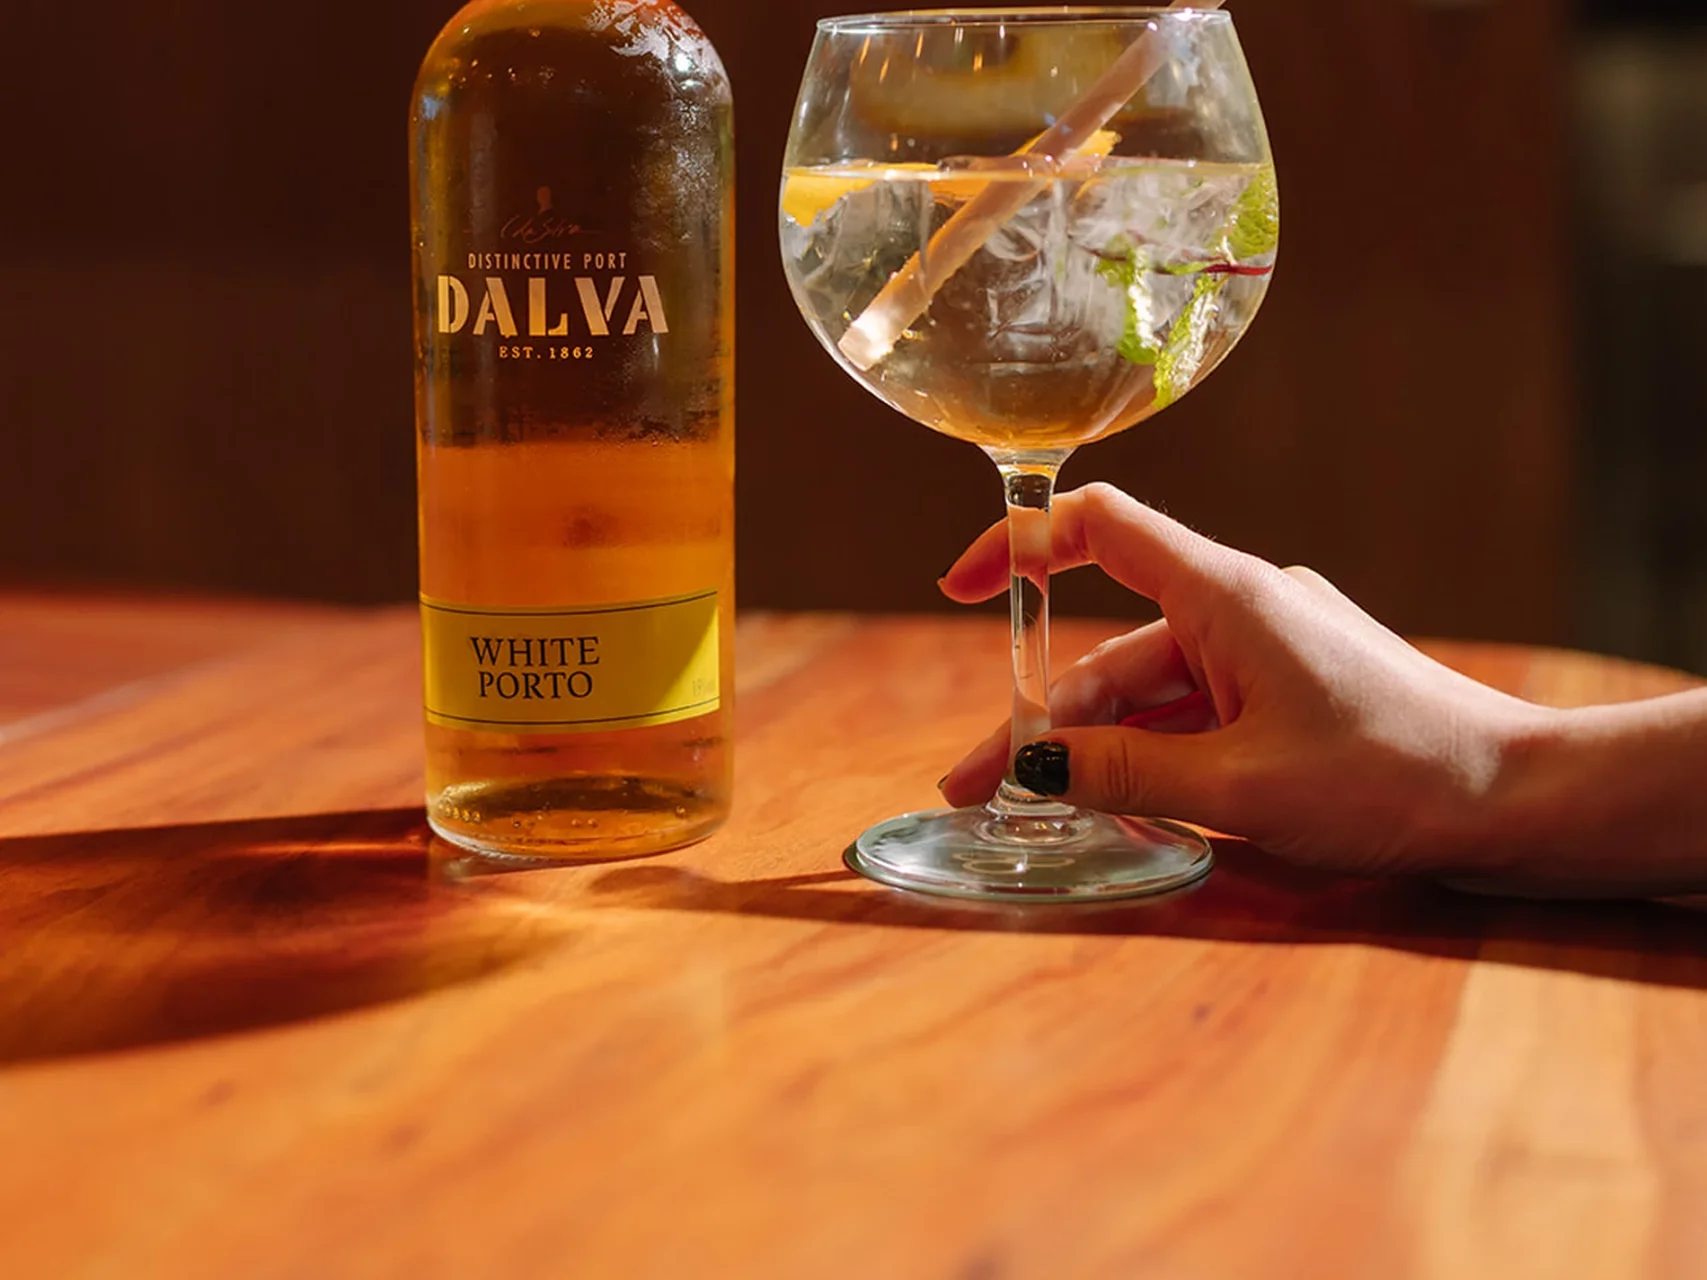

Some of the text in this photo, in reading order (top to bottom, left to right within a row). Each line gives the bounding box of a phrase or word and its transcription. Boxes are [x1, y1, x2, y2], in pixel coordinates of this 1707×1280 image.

[468, 252, 627, 271] DISTINCTIVE PORT
[437, 275, 669, 338] DALVA
[499, 345, 594, 360] EST. 1862
[469, 636, 601, 667] WHITE
[478, 671, 593, 700] PORTO
